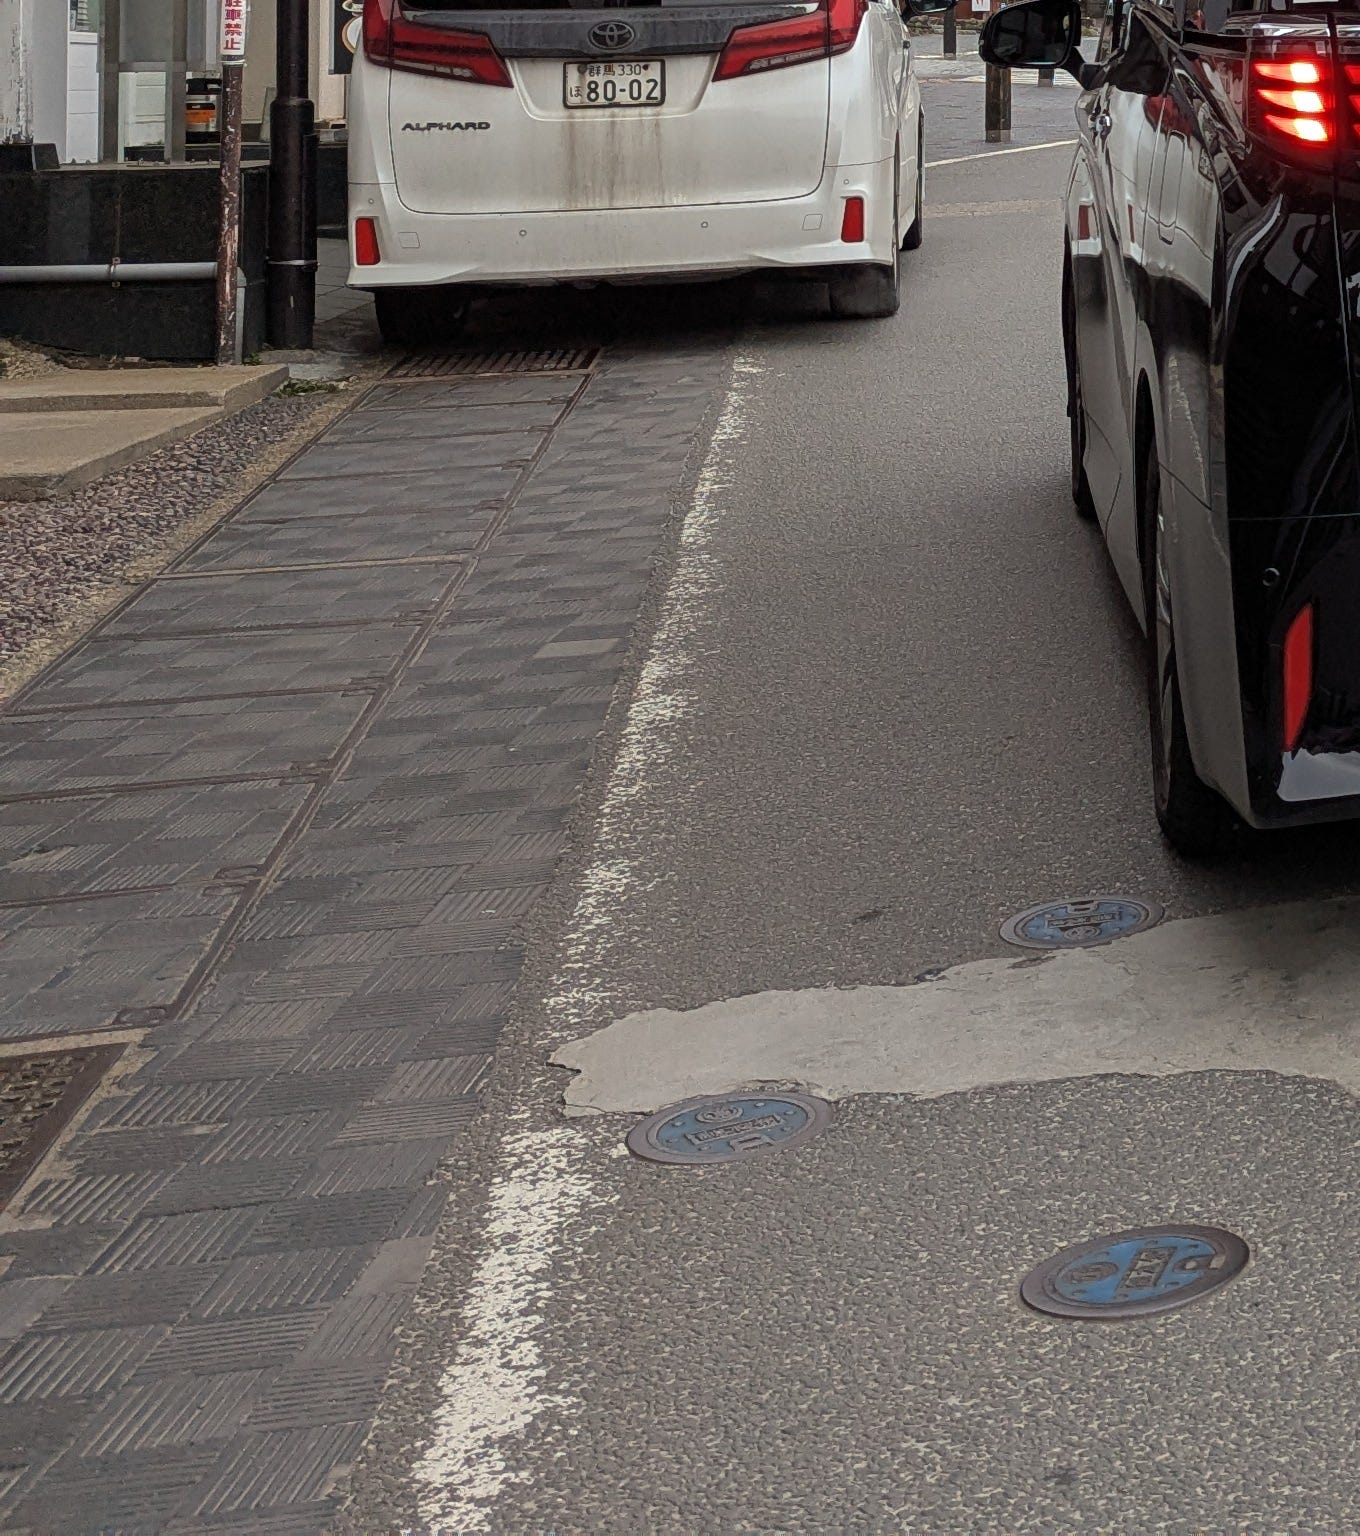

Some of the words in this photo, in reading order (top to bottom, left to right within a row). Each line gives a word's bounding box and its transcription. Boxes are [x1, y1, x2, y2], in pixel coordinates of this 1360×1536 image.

[569, 85, 583, 98] ほ
[586, 79, 659, 103] 80-02
[401, 121, 491, 132] ALPHARD
